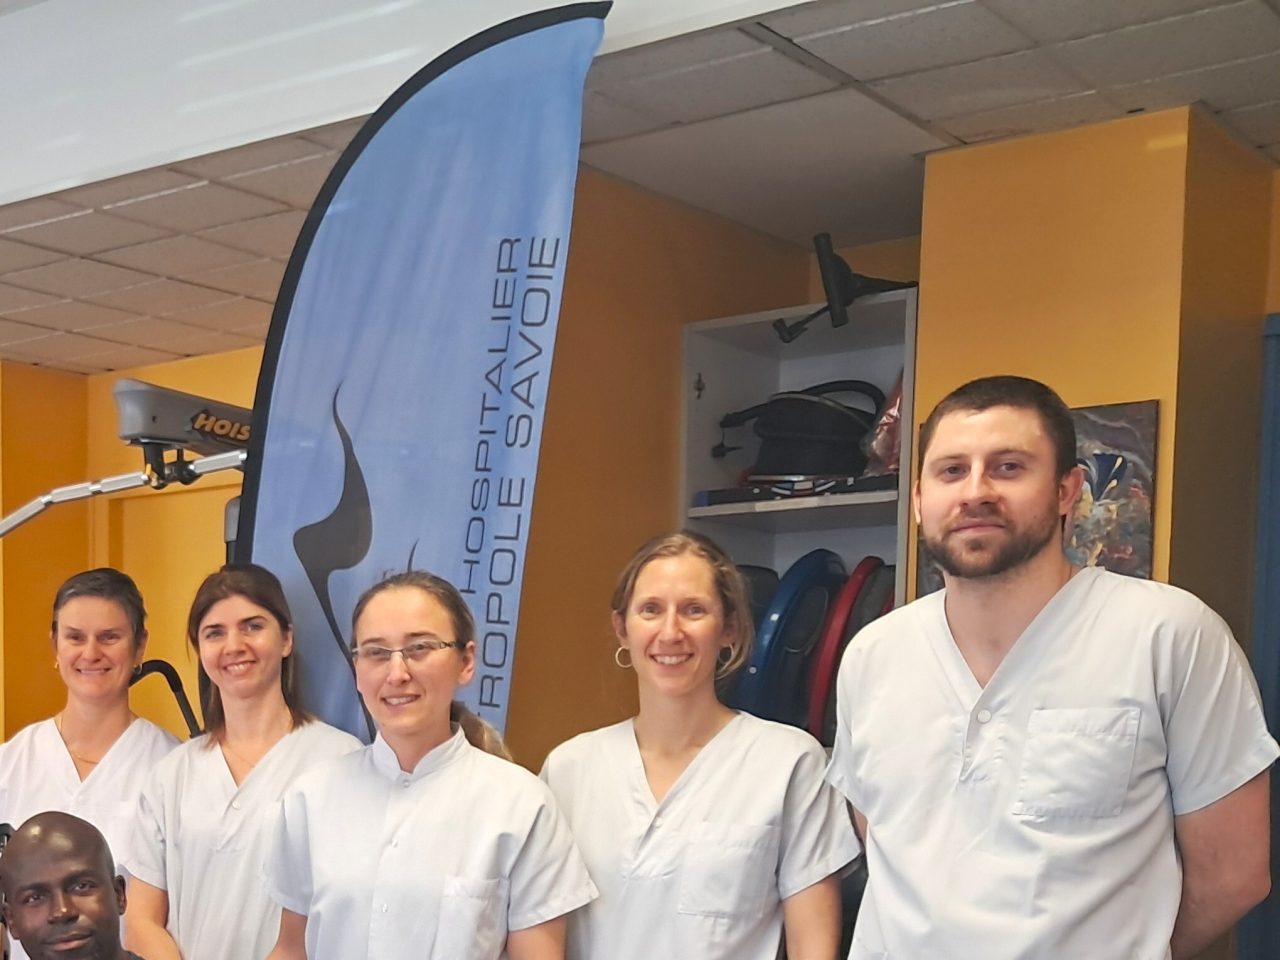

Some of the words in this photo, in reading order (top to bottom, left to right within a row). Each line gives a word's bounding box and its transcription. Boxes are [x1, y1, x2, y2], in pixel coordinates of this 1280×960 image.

[460, 236, 523, 594] HOSPITALIER
[478, 477, 526, 716] ROPOLE
[505, 236, 561, 449] SAVOIE
